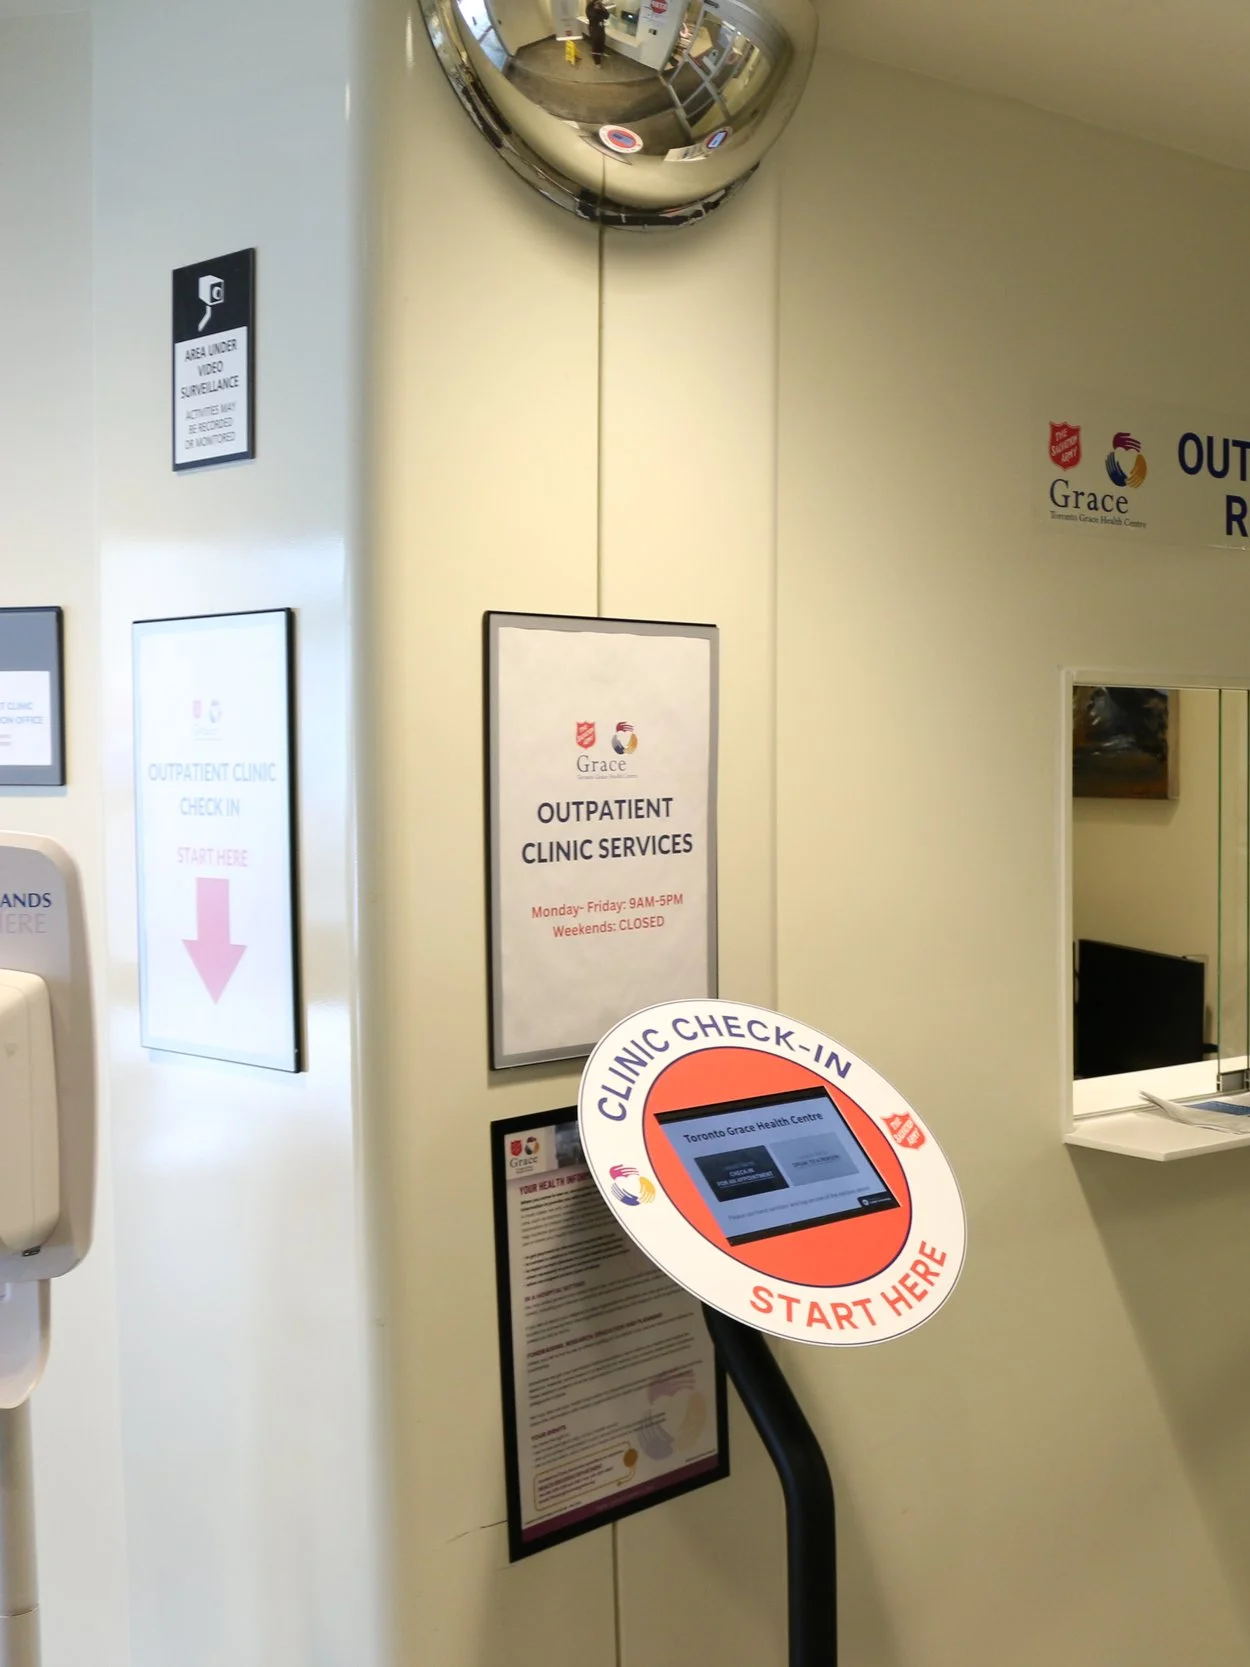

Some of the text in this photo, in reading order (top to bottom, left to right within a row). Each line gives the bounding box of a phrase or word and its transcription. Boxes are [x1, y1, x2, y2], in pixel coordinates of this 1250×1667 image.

[185, 338, 237, 362] AREA UNDER
[198, 361, 223, 377] VIDEO
[180, 375, 239, 399] SURVEILLANCE
[188, 416, 233, 435] BE RECORDED
[195, 431, 236, 448] MONITORED
[1050, 478, 1128, 514] Grace
[1079, 513, 1099, 523] Grace
[1100, 515, 1122, 526] Health
[148, 762, 276, 783] OUTPATIENT CLINIC
[576, 754, 626, 773] Grace
[180, 797, 240, 817] CHECK IN
[537, 797, 673, 824] OUTPATIENT
[177, 847, 248, 868] START HERE
[522, 833, 693, 864] CLINIC SERVICES
[532, 893, 684, 918] Monday- Friday: 9AM-5PM
[552, 915, 665, 938] Weekends: CLOSED
[597, 1014, 852, 1122] CLINIC CHECK-IN
[683, 1111, 823, 1144] Toronto Grace Health Centre
[510, 1156, 538, 1169] Grace
[519, 1184, 537, 1195] YOUR
[538, 1177, 565, 1190] HEALTH
[749, 1285, 876, 1331] START
[880, 1240, 948, 1318] HERE
